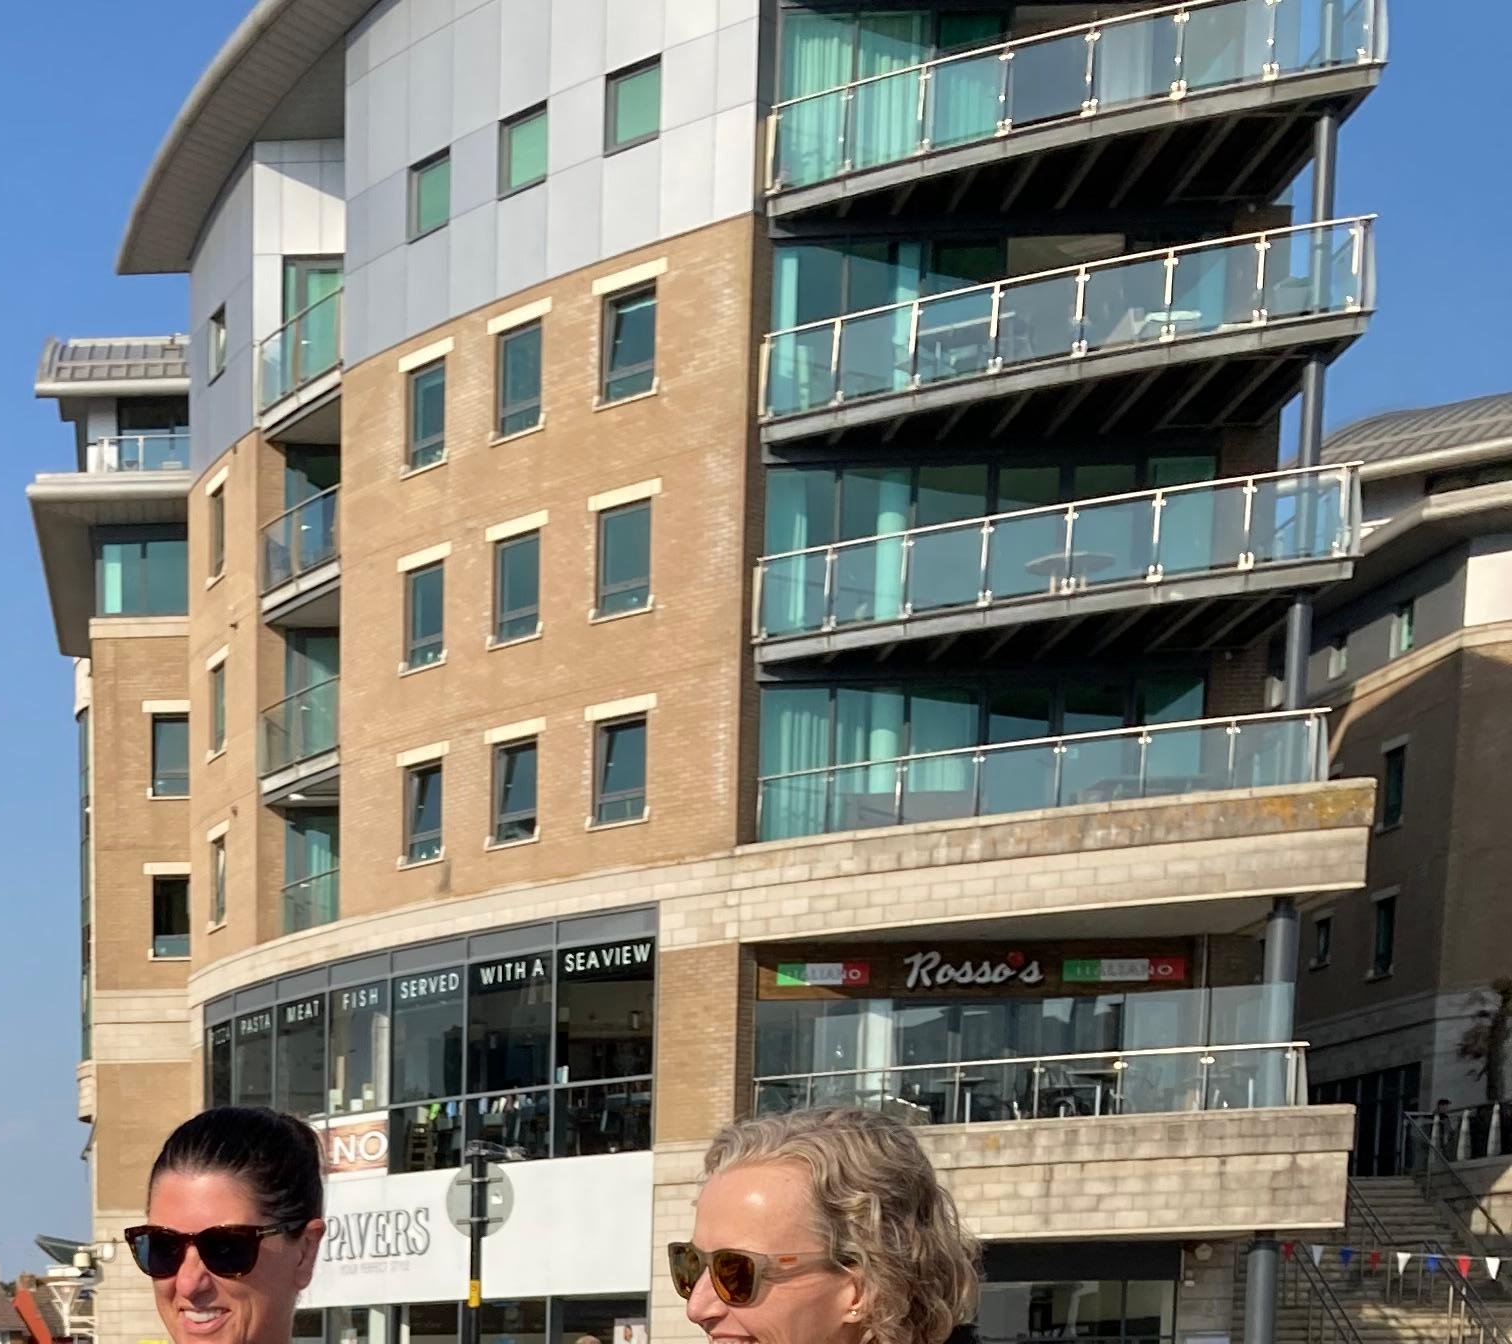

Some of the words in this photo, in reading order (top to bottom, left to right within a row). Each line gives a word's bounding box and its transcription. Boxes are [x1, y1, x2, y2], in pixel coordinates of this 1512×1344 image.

[240, 1013, 272, 1036] PASTA
[286, 1000, 320, 1024] MEAT
[342, 988, 379, 1011] FISH
[400, 972, 460, 999] SERVED
[480, 961, 527, 985] WITH
[532, 958, 545, 977] A
[904, 951, 1044, 988] Rosso's
[322, 1206, 431, 1262] PAVERS
